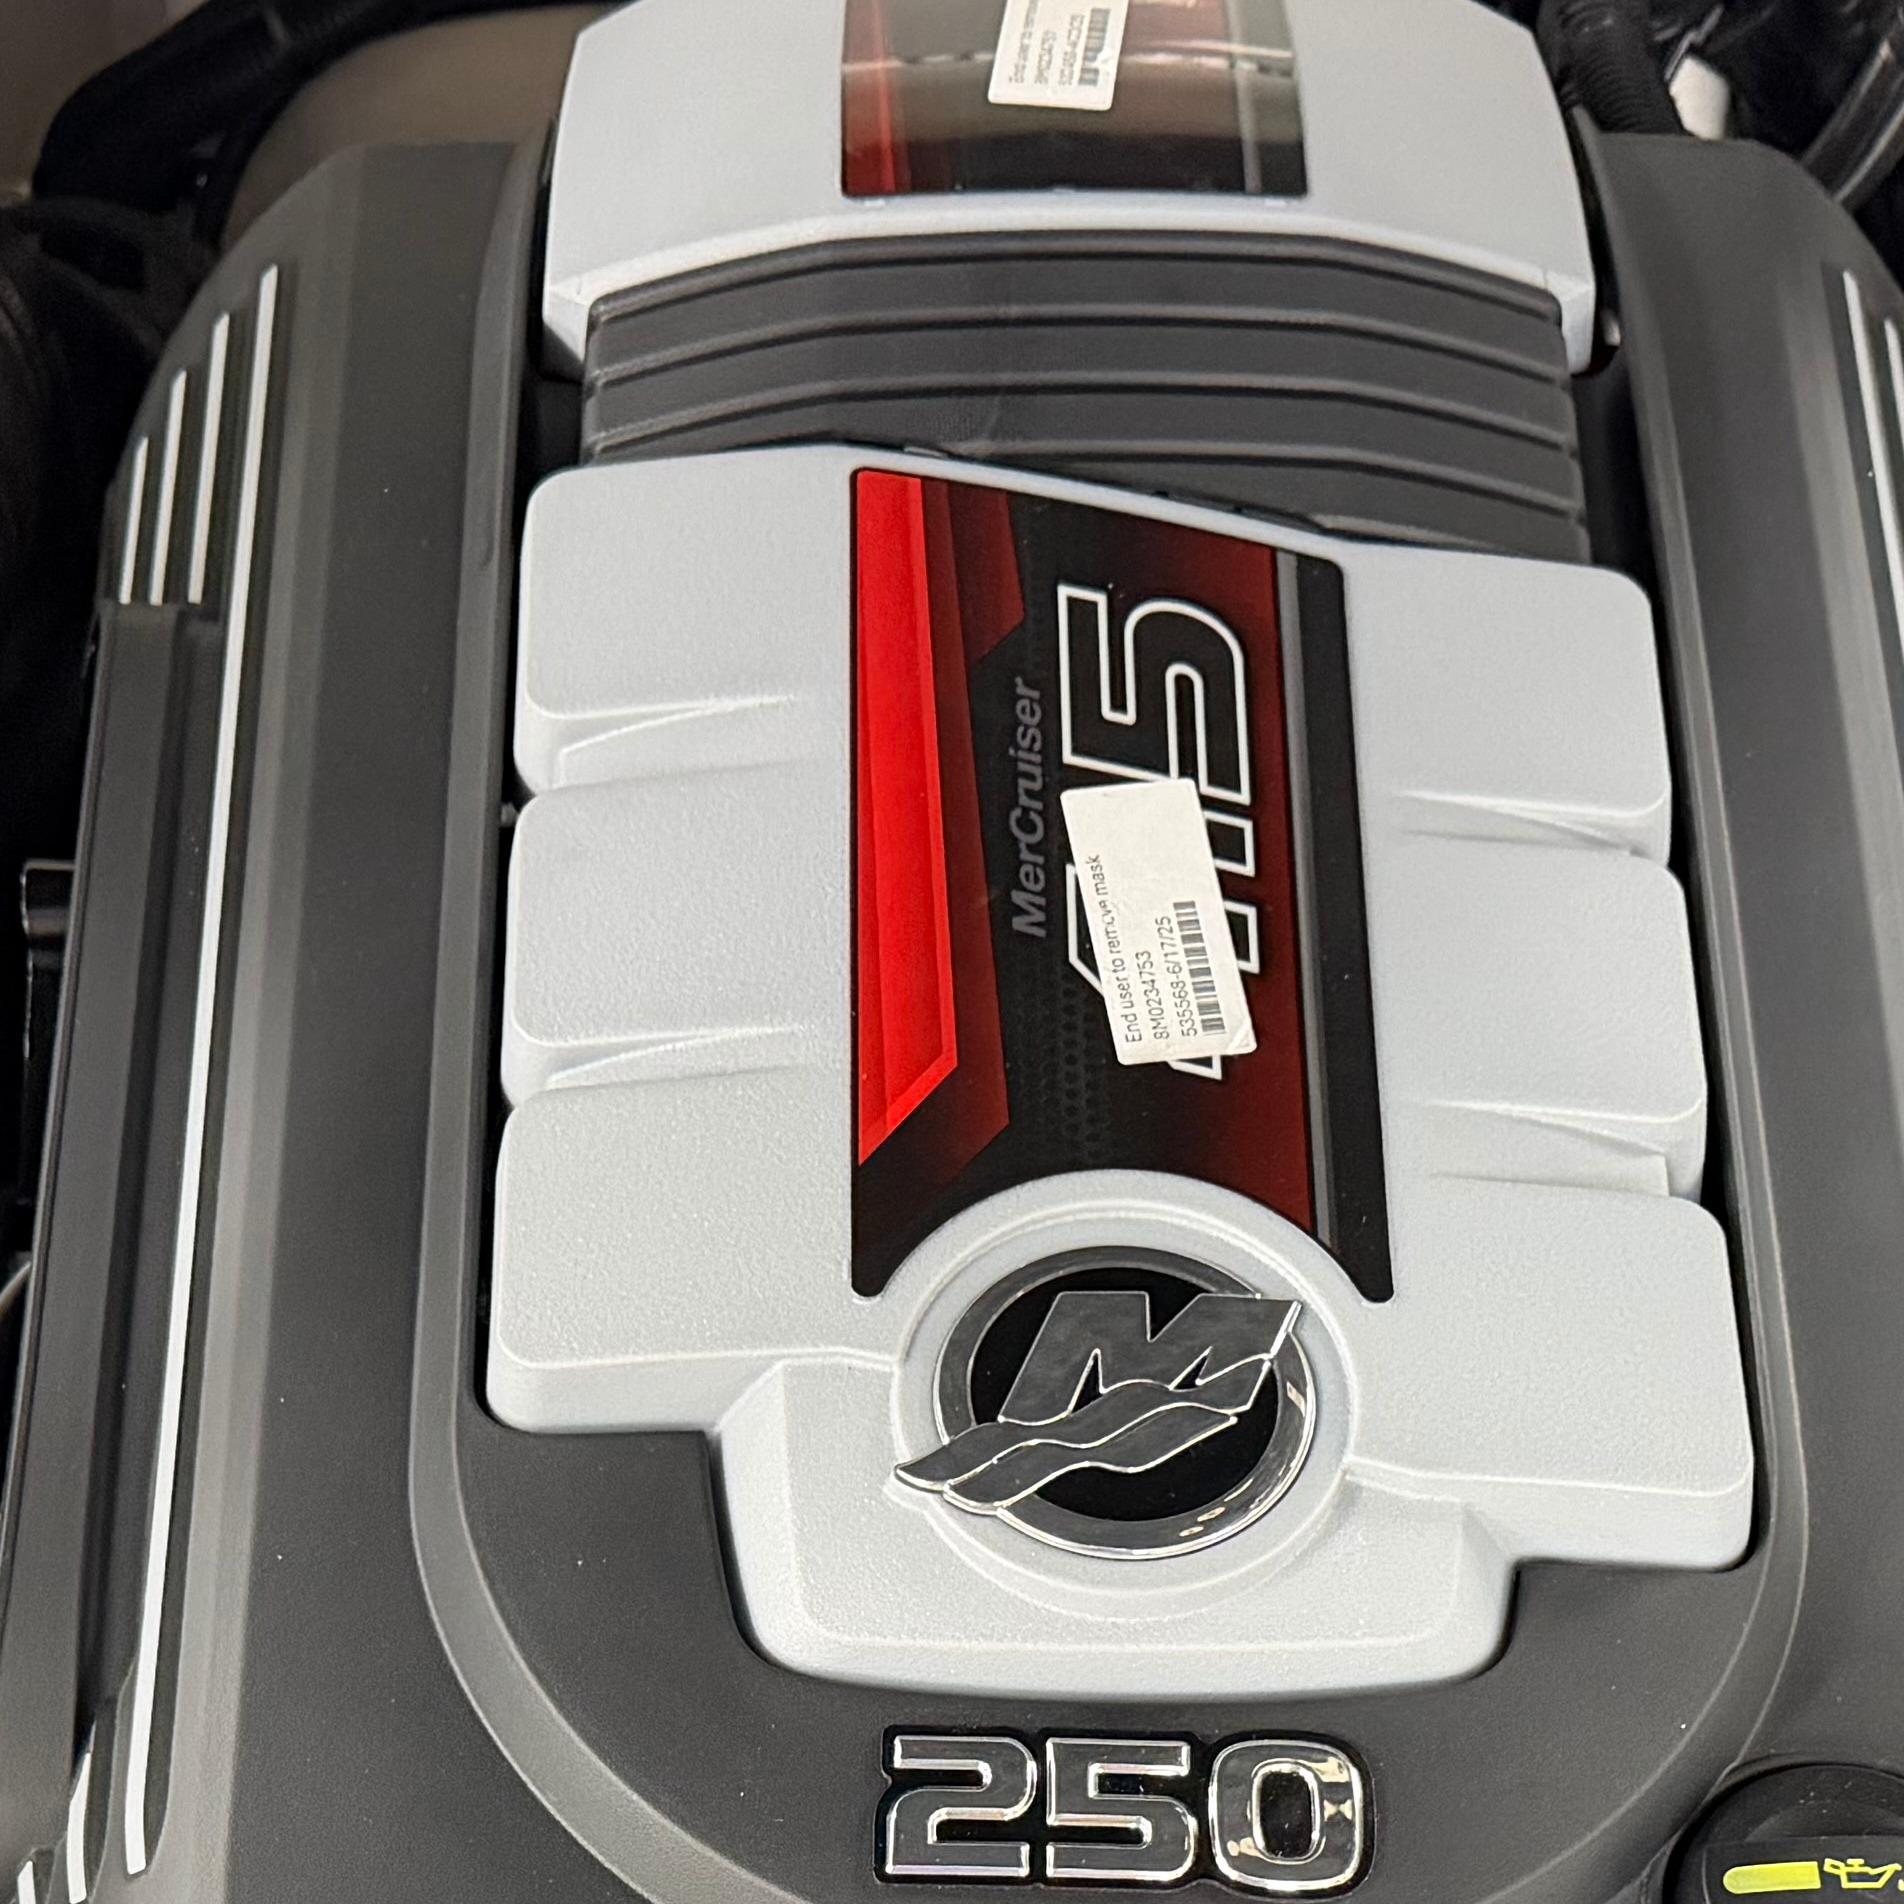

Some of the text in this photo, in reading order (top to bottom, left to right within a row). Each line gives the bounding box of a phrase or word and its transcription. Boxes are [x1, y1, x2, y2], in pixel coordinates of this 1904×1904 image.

[1010, 676, 1047, 938] MerCruiser
[1085, 854, 1108, 896] mask
[1112, 957, 1125, 974] to
[1116, 976, 1133, 1008] user
[1120, 1010, 1142, 1043] End
[884, 1732, 1364, 1893] 250
